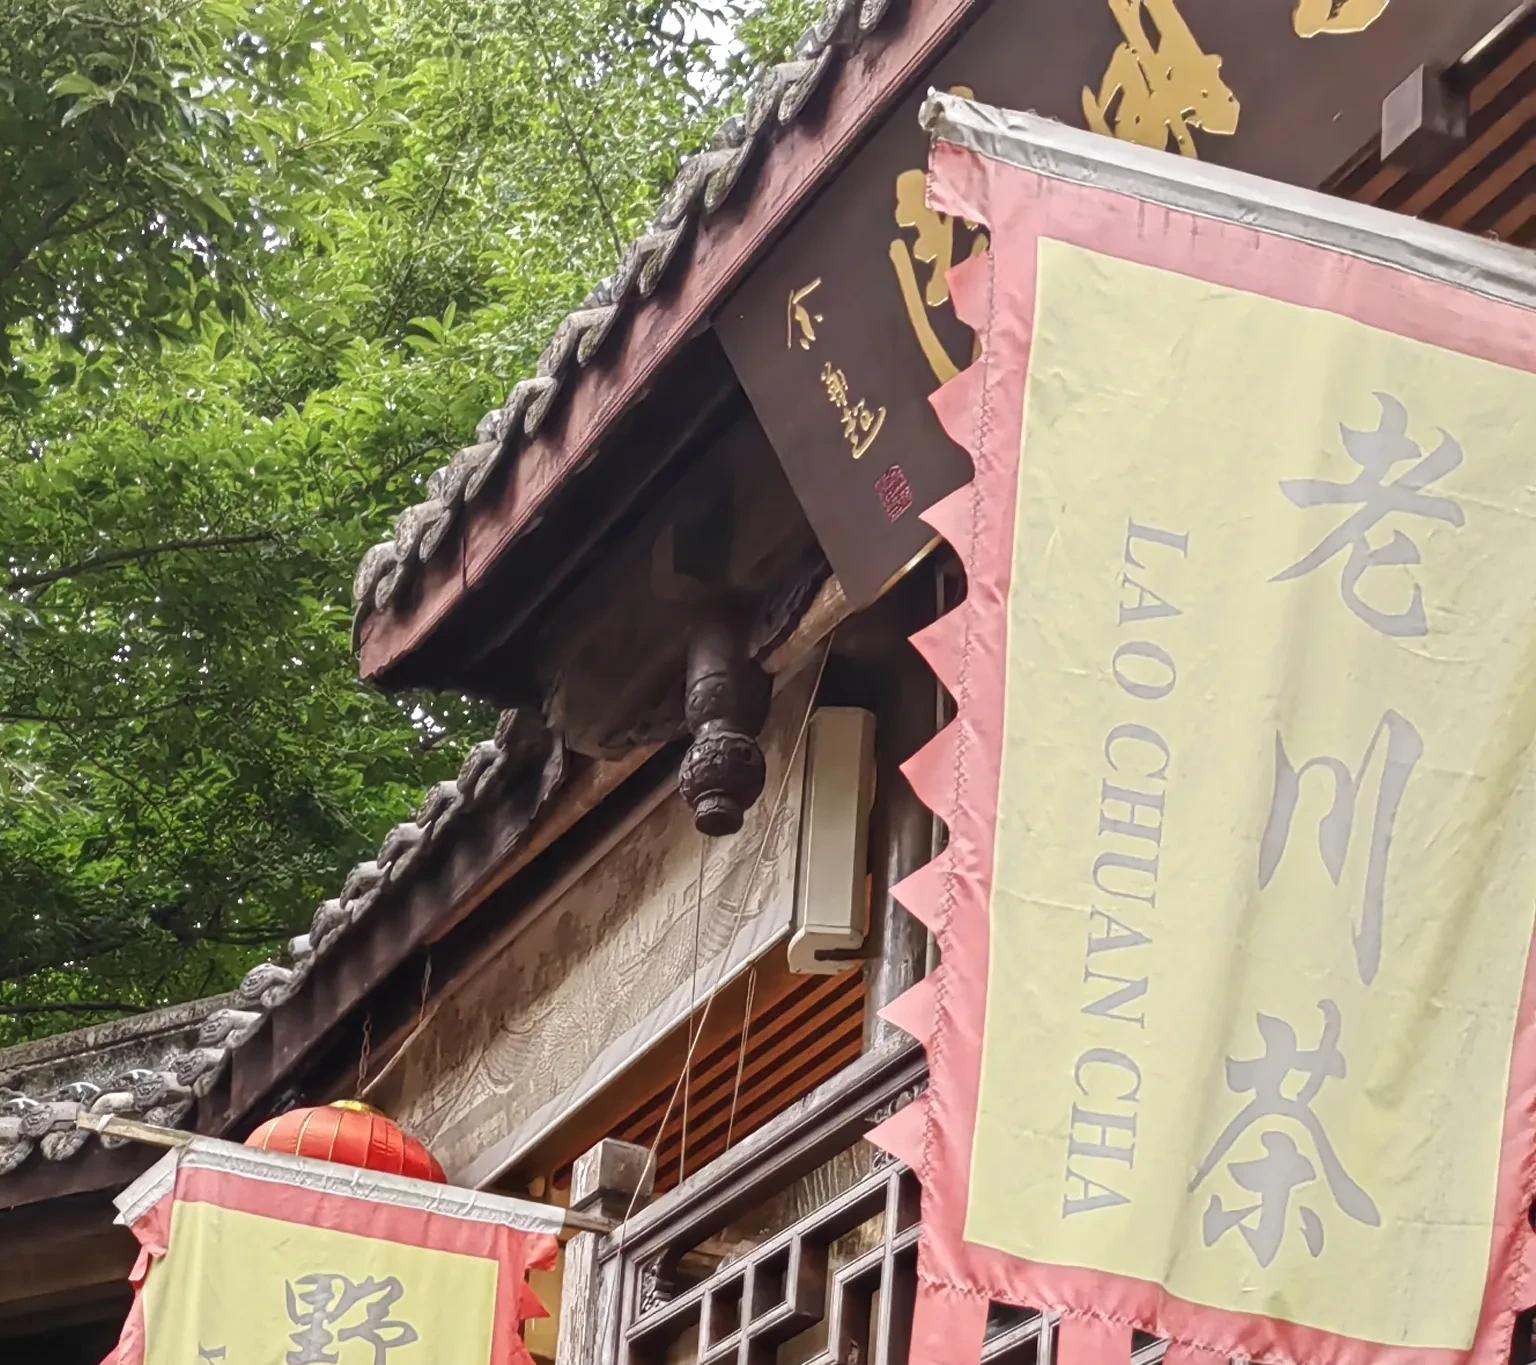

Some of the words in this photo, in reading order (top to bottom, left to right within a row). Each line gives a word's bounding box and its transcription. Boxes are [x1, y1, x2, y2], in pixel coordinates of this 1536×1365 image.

[1112, 515, 1190, 700] LAO
[1082, 722, 1170, 1031] CHUAN
[1187, 390, 1465, 1269] 老川茶
[1061, 1047, 1144, 1220] CHA
